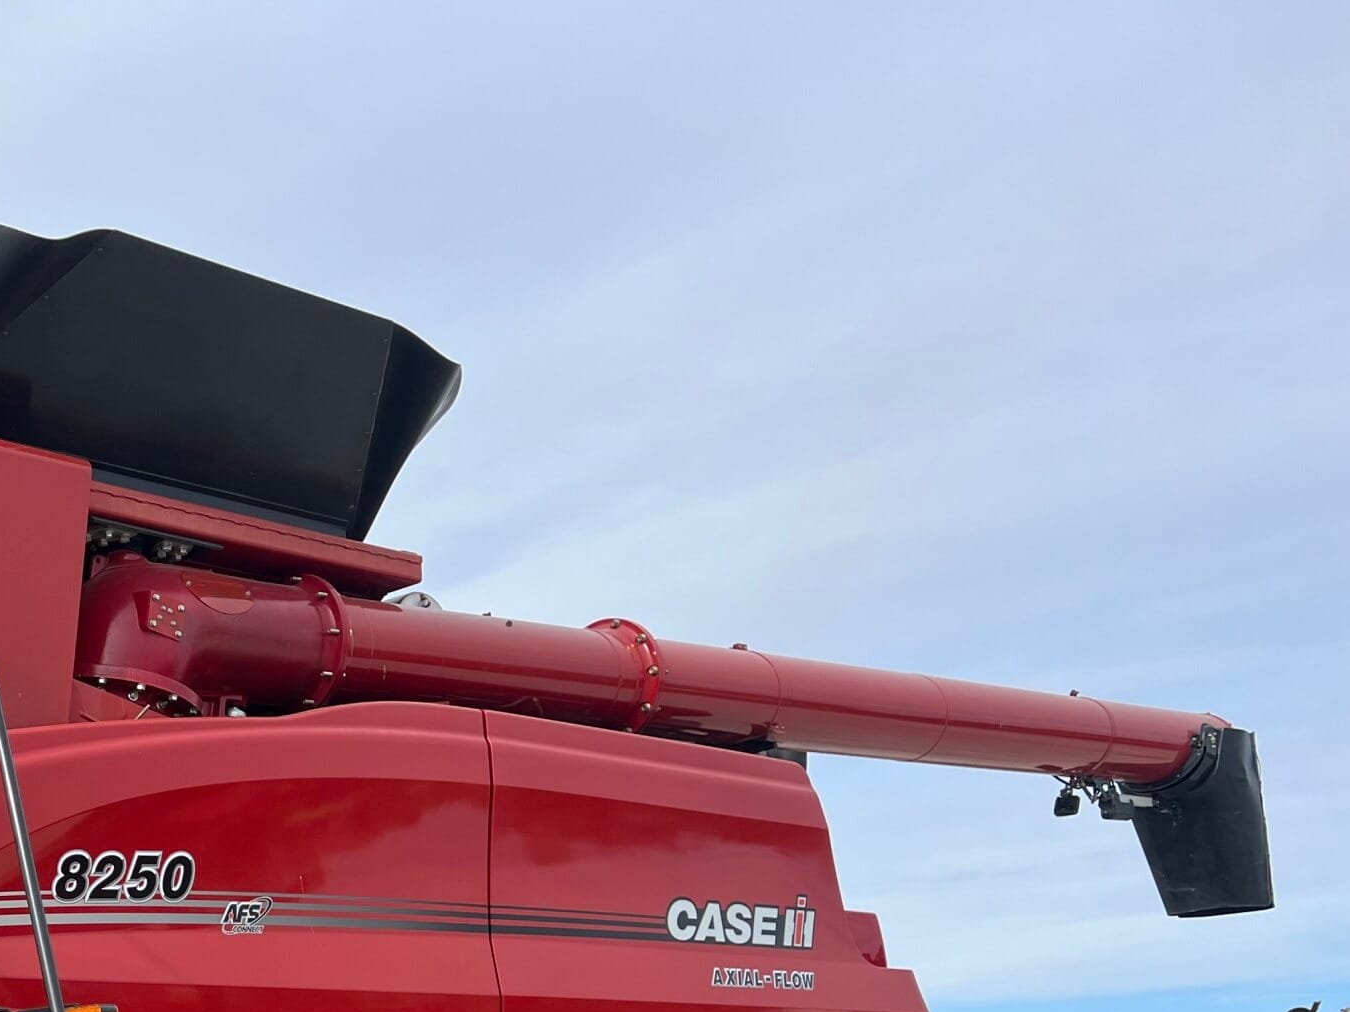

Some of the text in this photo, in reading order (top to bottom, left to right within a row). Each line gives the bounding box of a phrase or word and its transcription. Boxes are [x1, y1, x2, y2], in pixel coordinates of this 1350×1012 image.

[52, 849, 195, 904] 8250
[221, 901, 263, 924] AFS
[667, 897, 779, 946] CASE
[232, 925, 264, 934] CONNECT
[711, 967, 814, 991] AXIAL-FLOW
